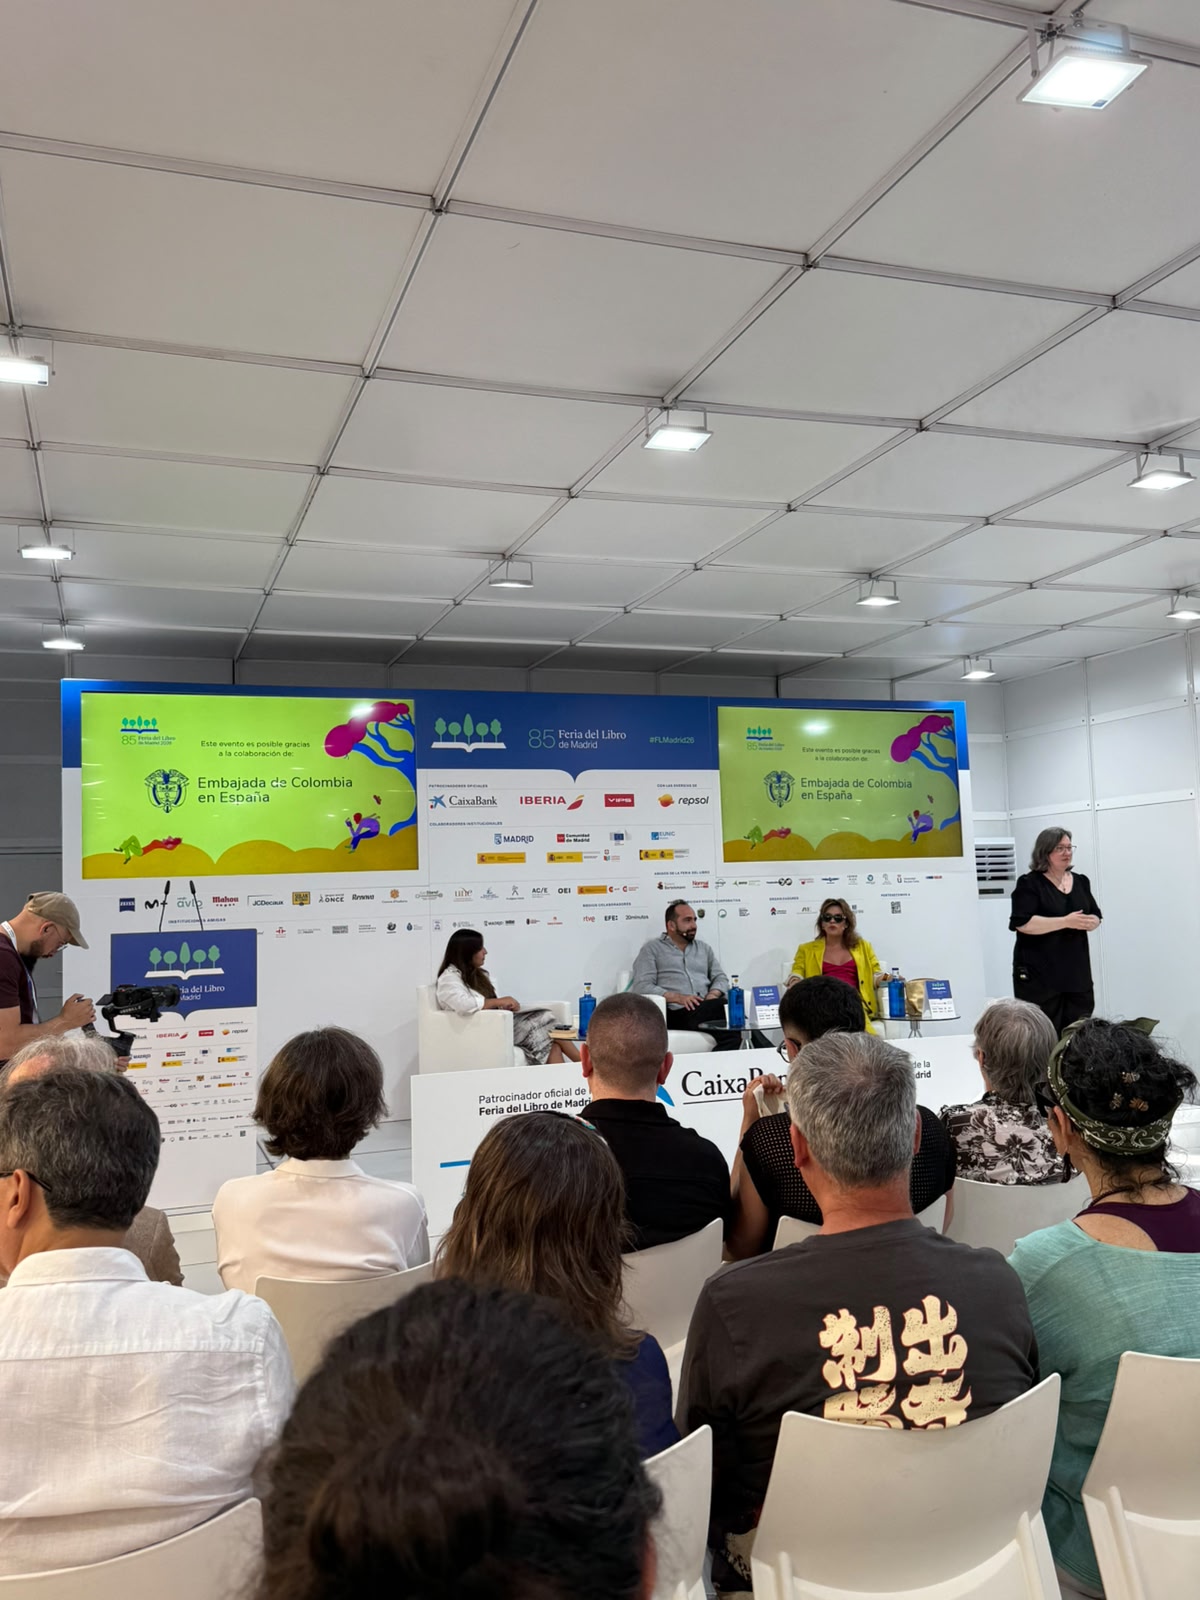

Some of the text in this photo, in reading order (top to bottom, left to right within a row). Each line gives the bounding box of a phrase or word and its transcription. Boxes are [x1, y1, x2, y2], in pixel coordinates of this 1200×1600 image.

[121, 734, 137, 746] 85
[528, 728, 556, 748] 85
[558, 729, 626, 740] Feria del Libro
[650, 736, 694, 744] #FLMadrid26
[558, 740, 598, 749] de Madrid
[198, 776, 353, 790] Embajada de Colombia
[801, 778, 912, 790] Embajada de Colombia
[198, 792, 270, 806] en España
[448, 796, 498, 806] CaixaBank
[520, 796, 566, 805] IBERIA
[678, 796, 709, 806] repsol
[816, 790, 853, 802] España
[504, 835, 534, 844] MADRID
[191, 985, 202, 993] del
[915, 1071, 931, 1079] drid
[478, 1091, 541, 1104] Patrocinador
[544, 1088, 572, 1099] oficial
[574, 1087, 586, 1096] de
[479, 1097, 591, 1116] Feria del Libro de Madri
